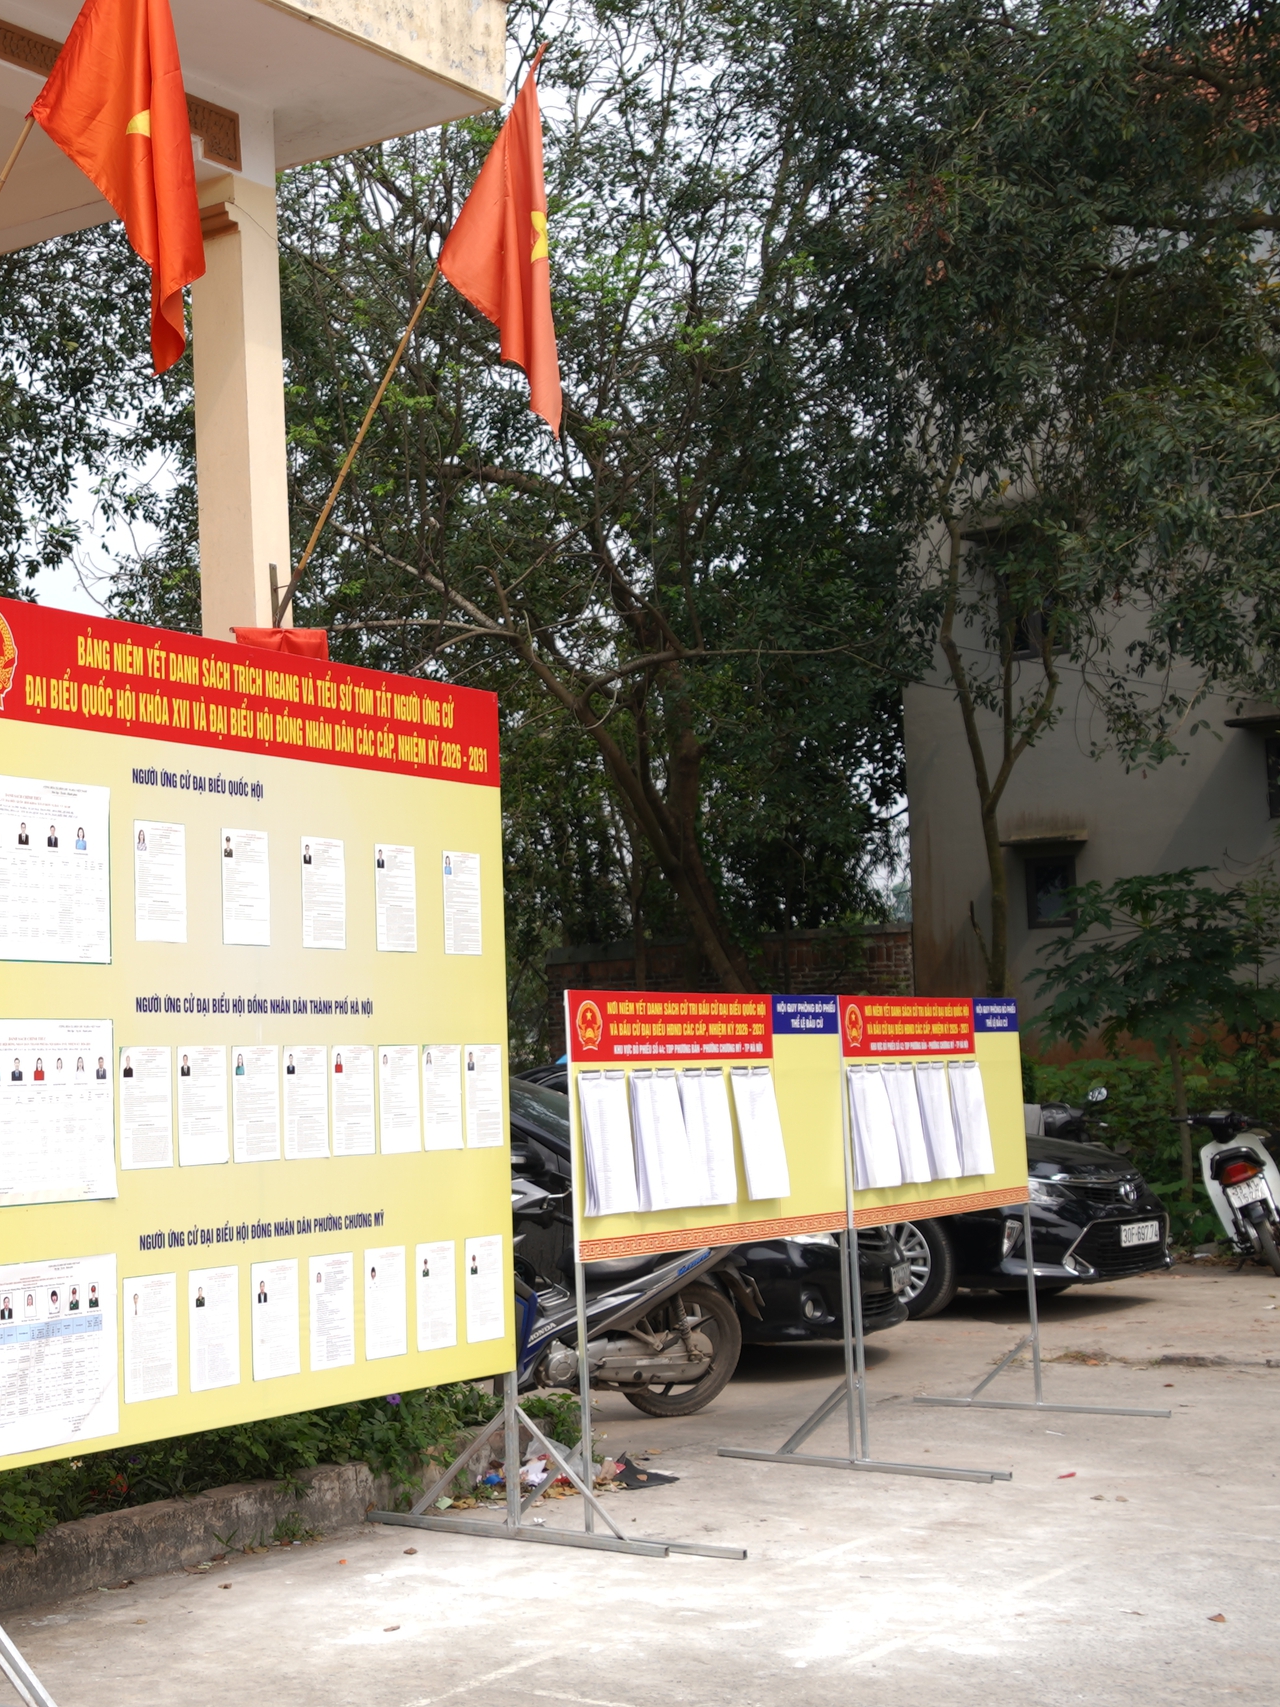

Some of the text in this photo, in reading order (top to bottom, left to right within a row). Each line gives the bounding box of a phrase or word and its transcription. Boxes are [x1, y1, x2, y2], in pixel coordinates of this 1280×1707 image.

[78, 627, 454, 728] BẢNG NIÊM YẾT DANH SÁCH TRÍCH NGANG VÀ TIỂU SỬ TÓM TẮT NGƯỜI ỨNG CỬ
[140, 1210, 383, 1250] NGƯỜI ỨNG CỬ ĐẠI BIỂU HỘI ĐỒNG NHÂN DÂN PHƯỜNG CHƯƠNG MỸ
[528, 1322, 557, 1343] HONDA
